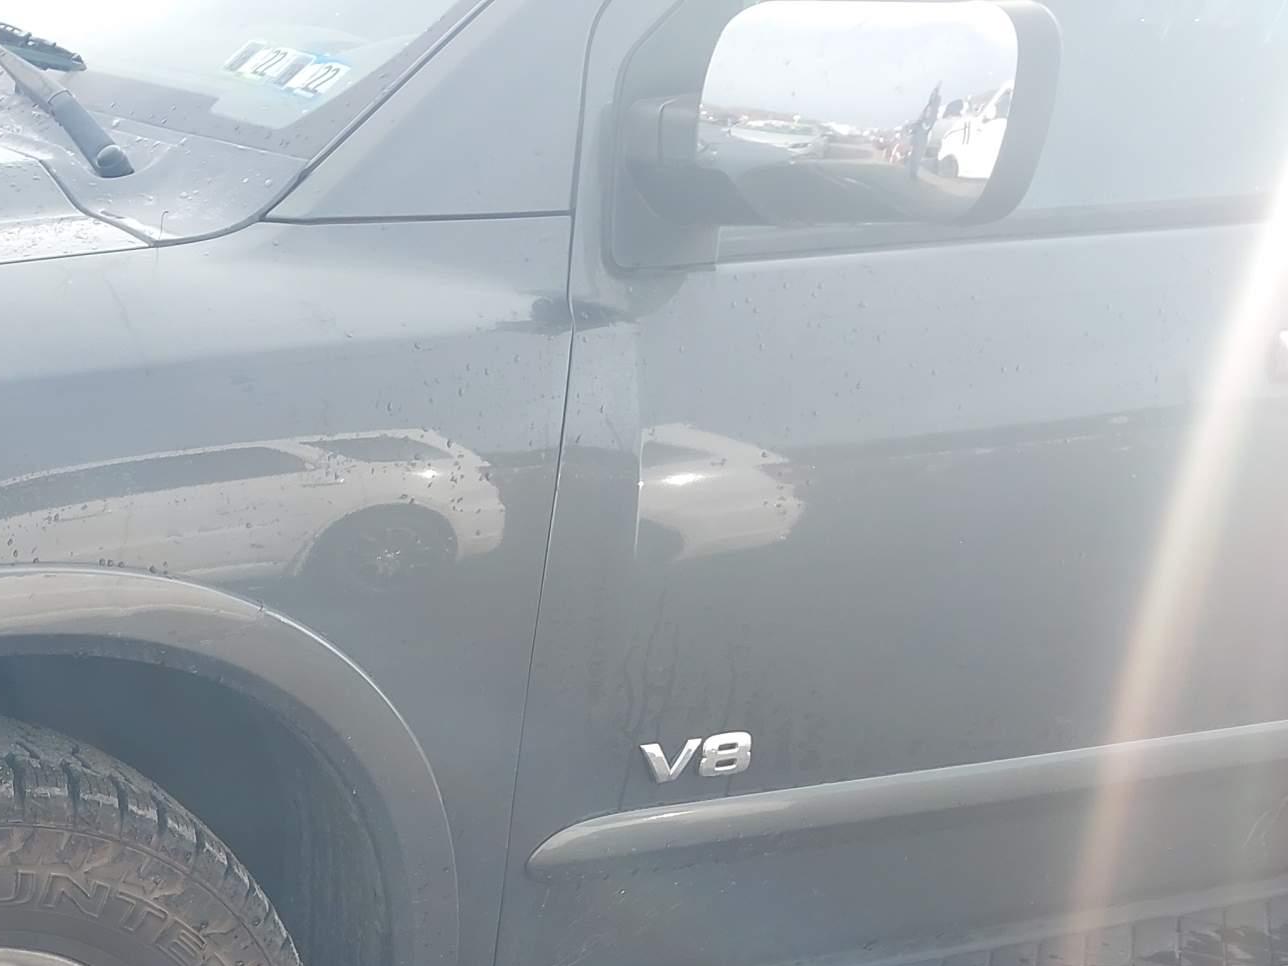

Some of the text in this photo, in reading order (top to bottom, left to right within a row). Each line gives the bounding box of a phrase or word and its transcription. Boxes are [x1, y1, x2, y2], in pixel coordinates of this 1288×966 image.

[252, 49, 288, 76] 22
[302, 64, 341, 94] 22
[639, 731, 752, 783] V8
